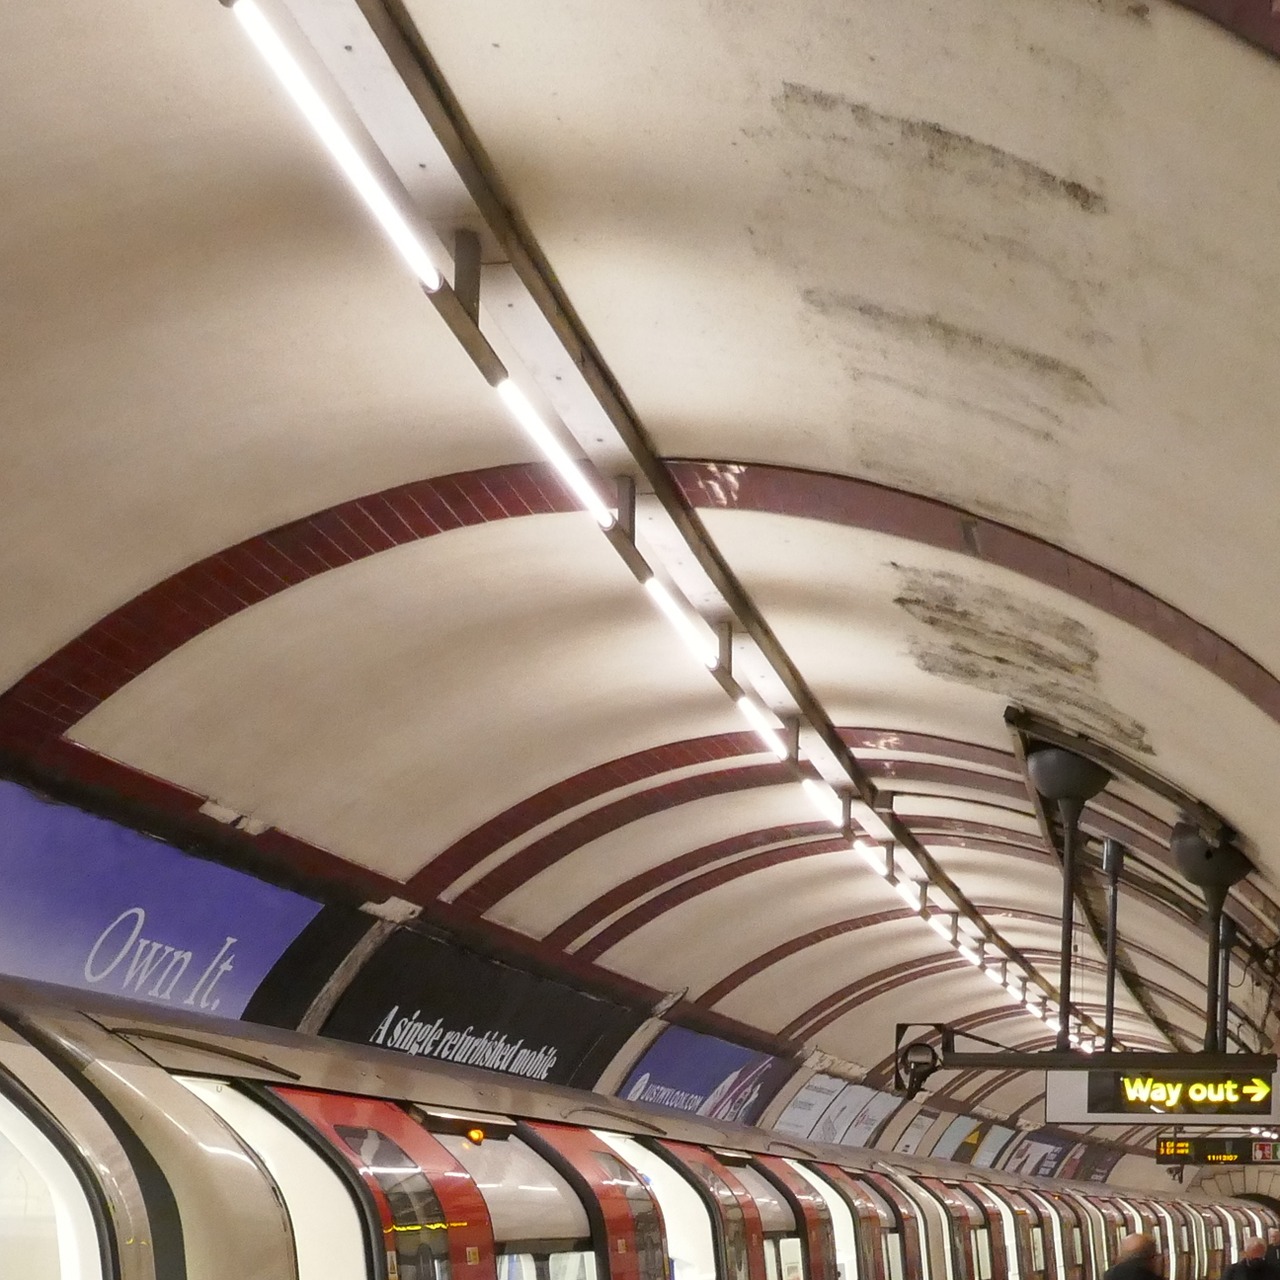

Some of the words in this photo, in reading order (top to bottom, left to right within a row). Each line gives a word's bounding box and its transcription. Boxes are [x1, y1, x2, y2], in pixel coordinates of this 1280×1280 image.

[84, 907, 193, 1000] Own
[184, 936, 238, 1011] It.
[369, 1005, 399, 1045] A
[387, 1010, 444, 1056] single
[433, 1026, 523, 1071] refurbished
[508, 1045, 557, 1080] mobile
[1123, 1077, 1182, 1106] Way
[1189, 1080, 1239, 1102] out
